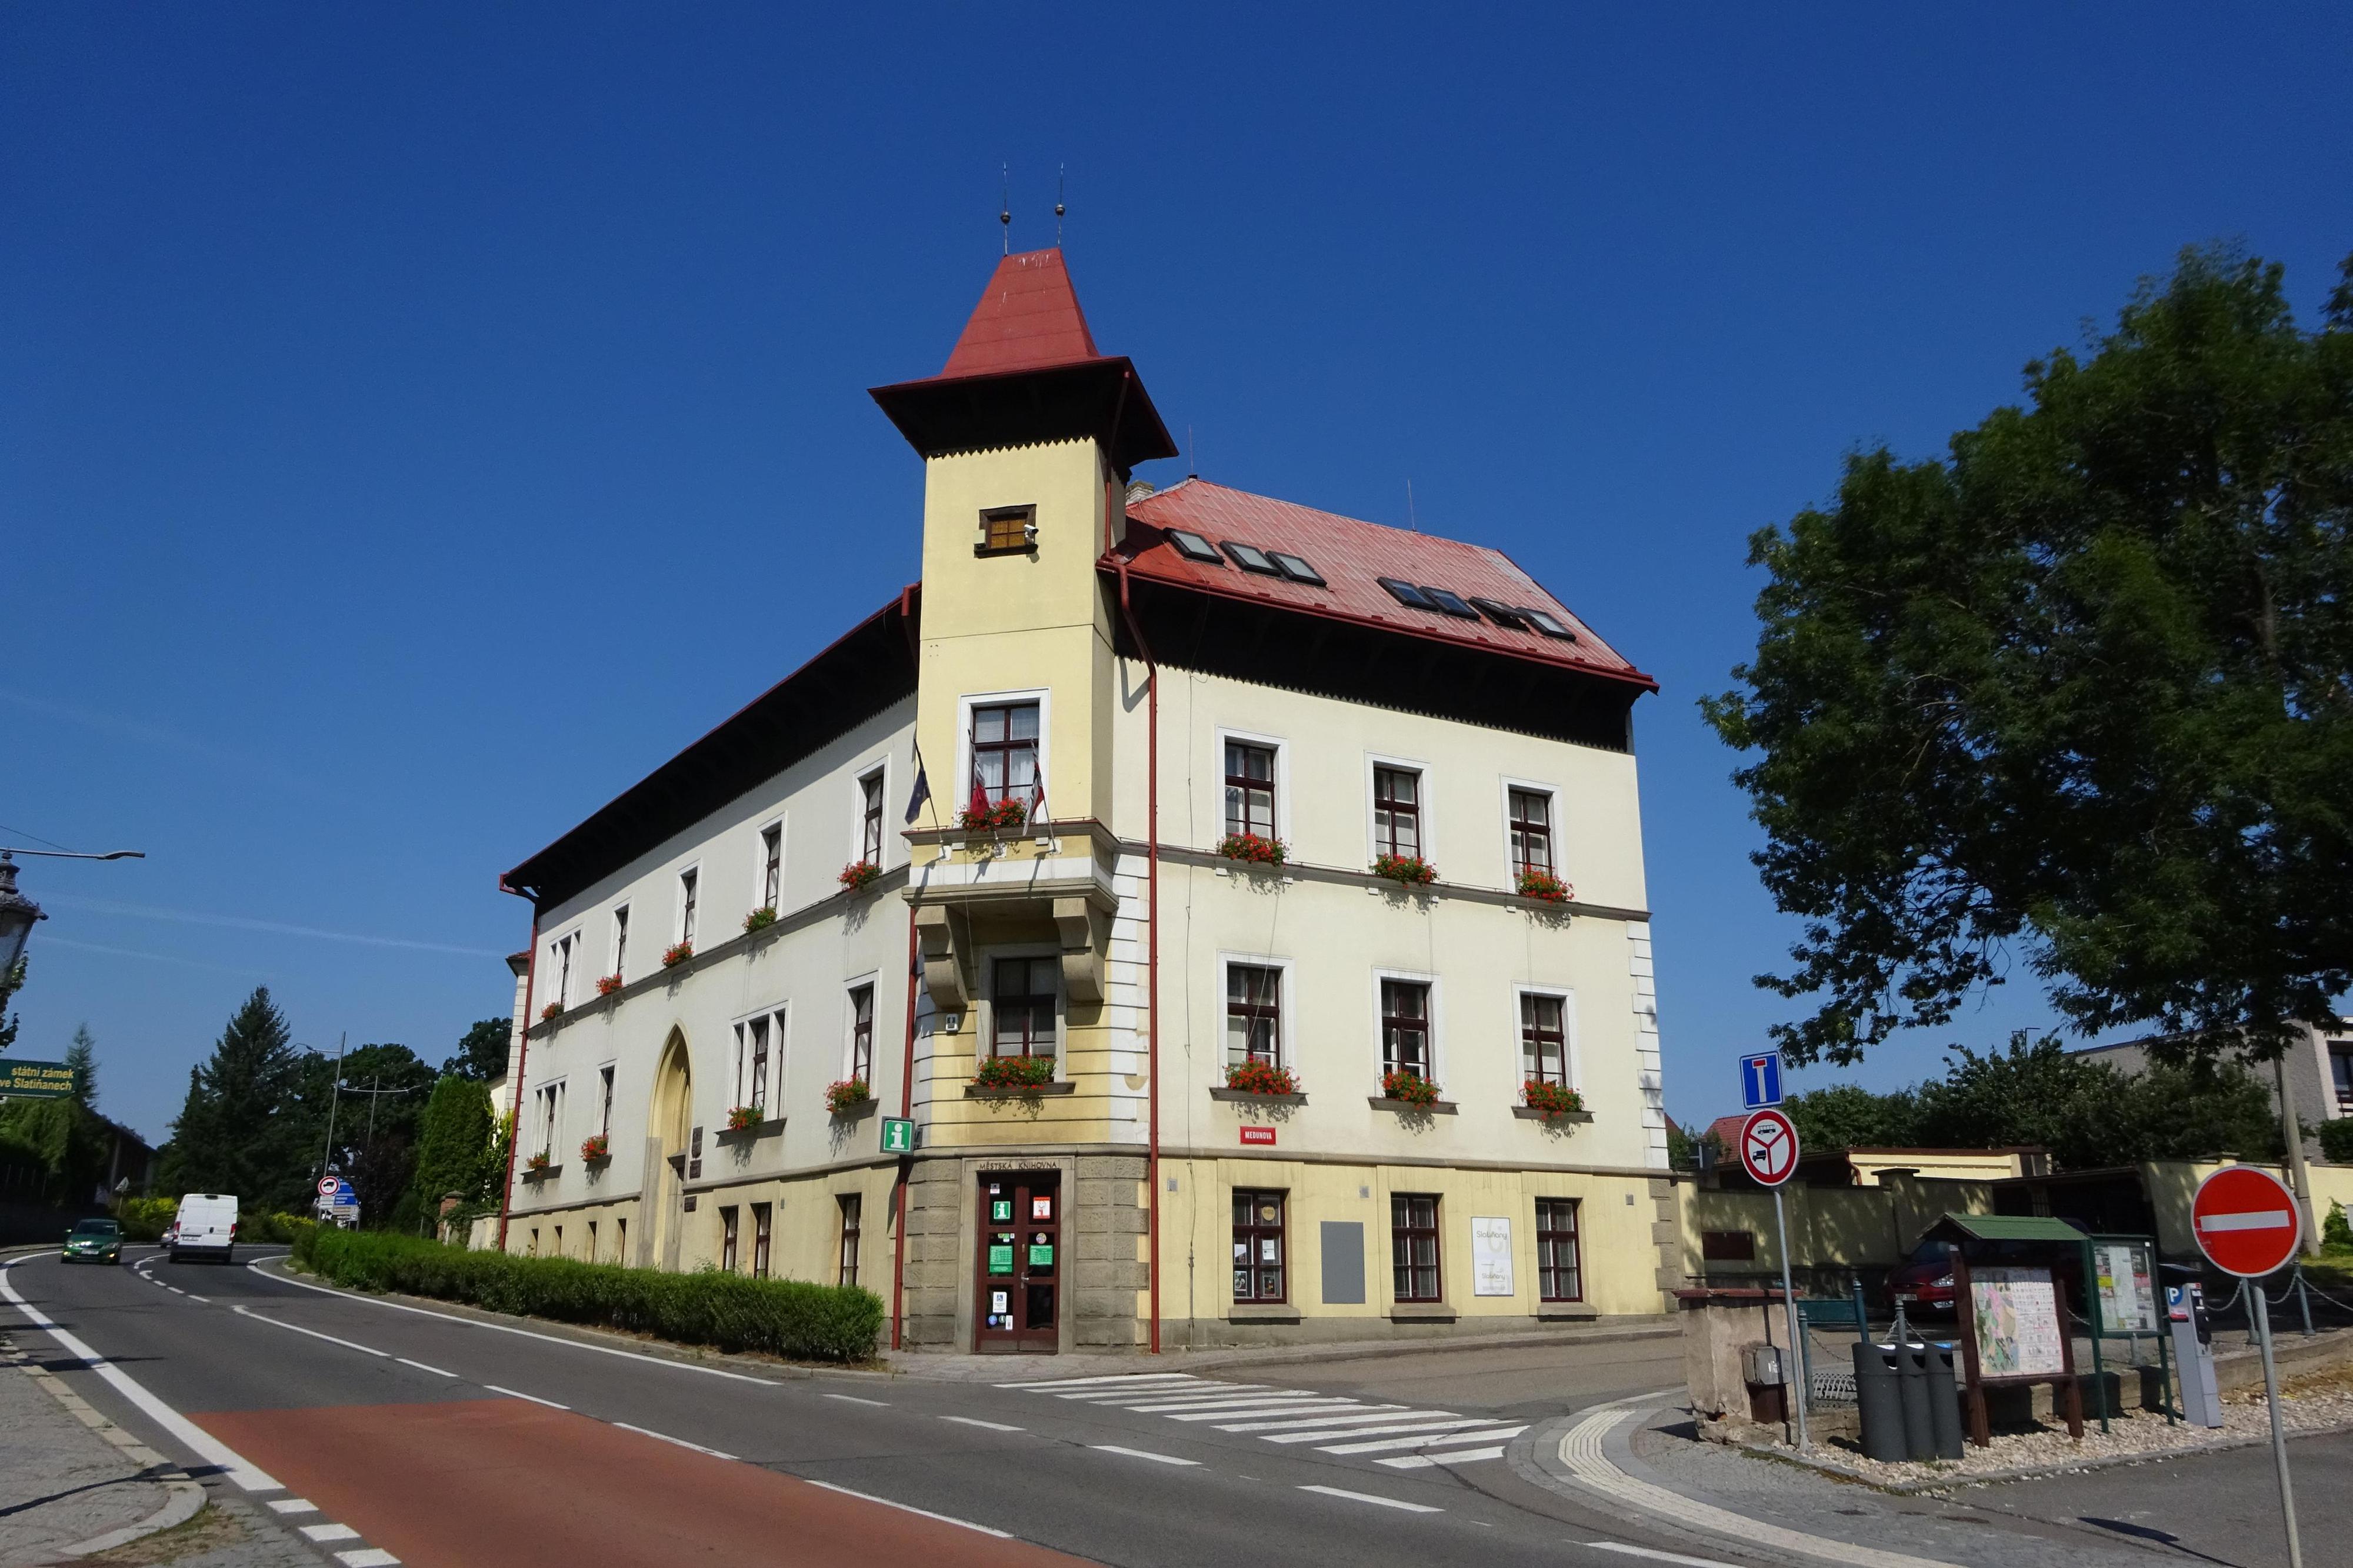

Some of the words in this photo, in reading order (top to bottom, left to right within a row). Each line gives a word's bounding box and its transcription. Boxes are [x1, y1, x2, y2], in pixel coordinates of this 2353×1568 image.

[11, 1066, 41, 1077] státní
[42, 1067, 74, 1079] zámek
[14, 1077, 72, 1090] Slatiňanech
[1245, 1130, 1272, 1140] MEDUNOVA
[979, 1161, 1012, 1170] MĚSTSKÁ
[2169, 1288, 2179, 1303] P
